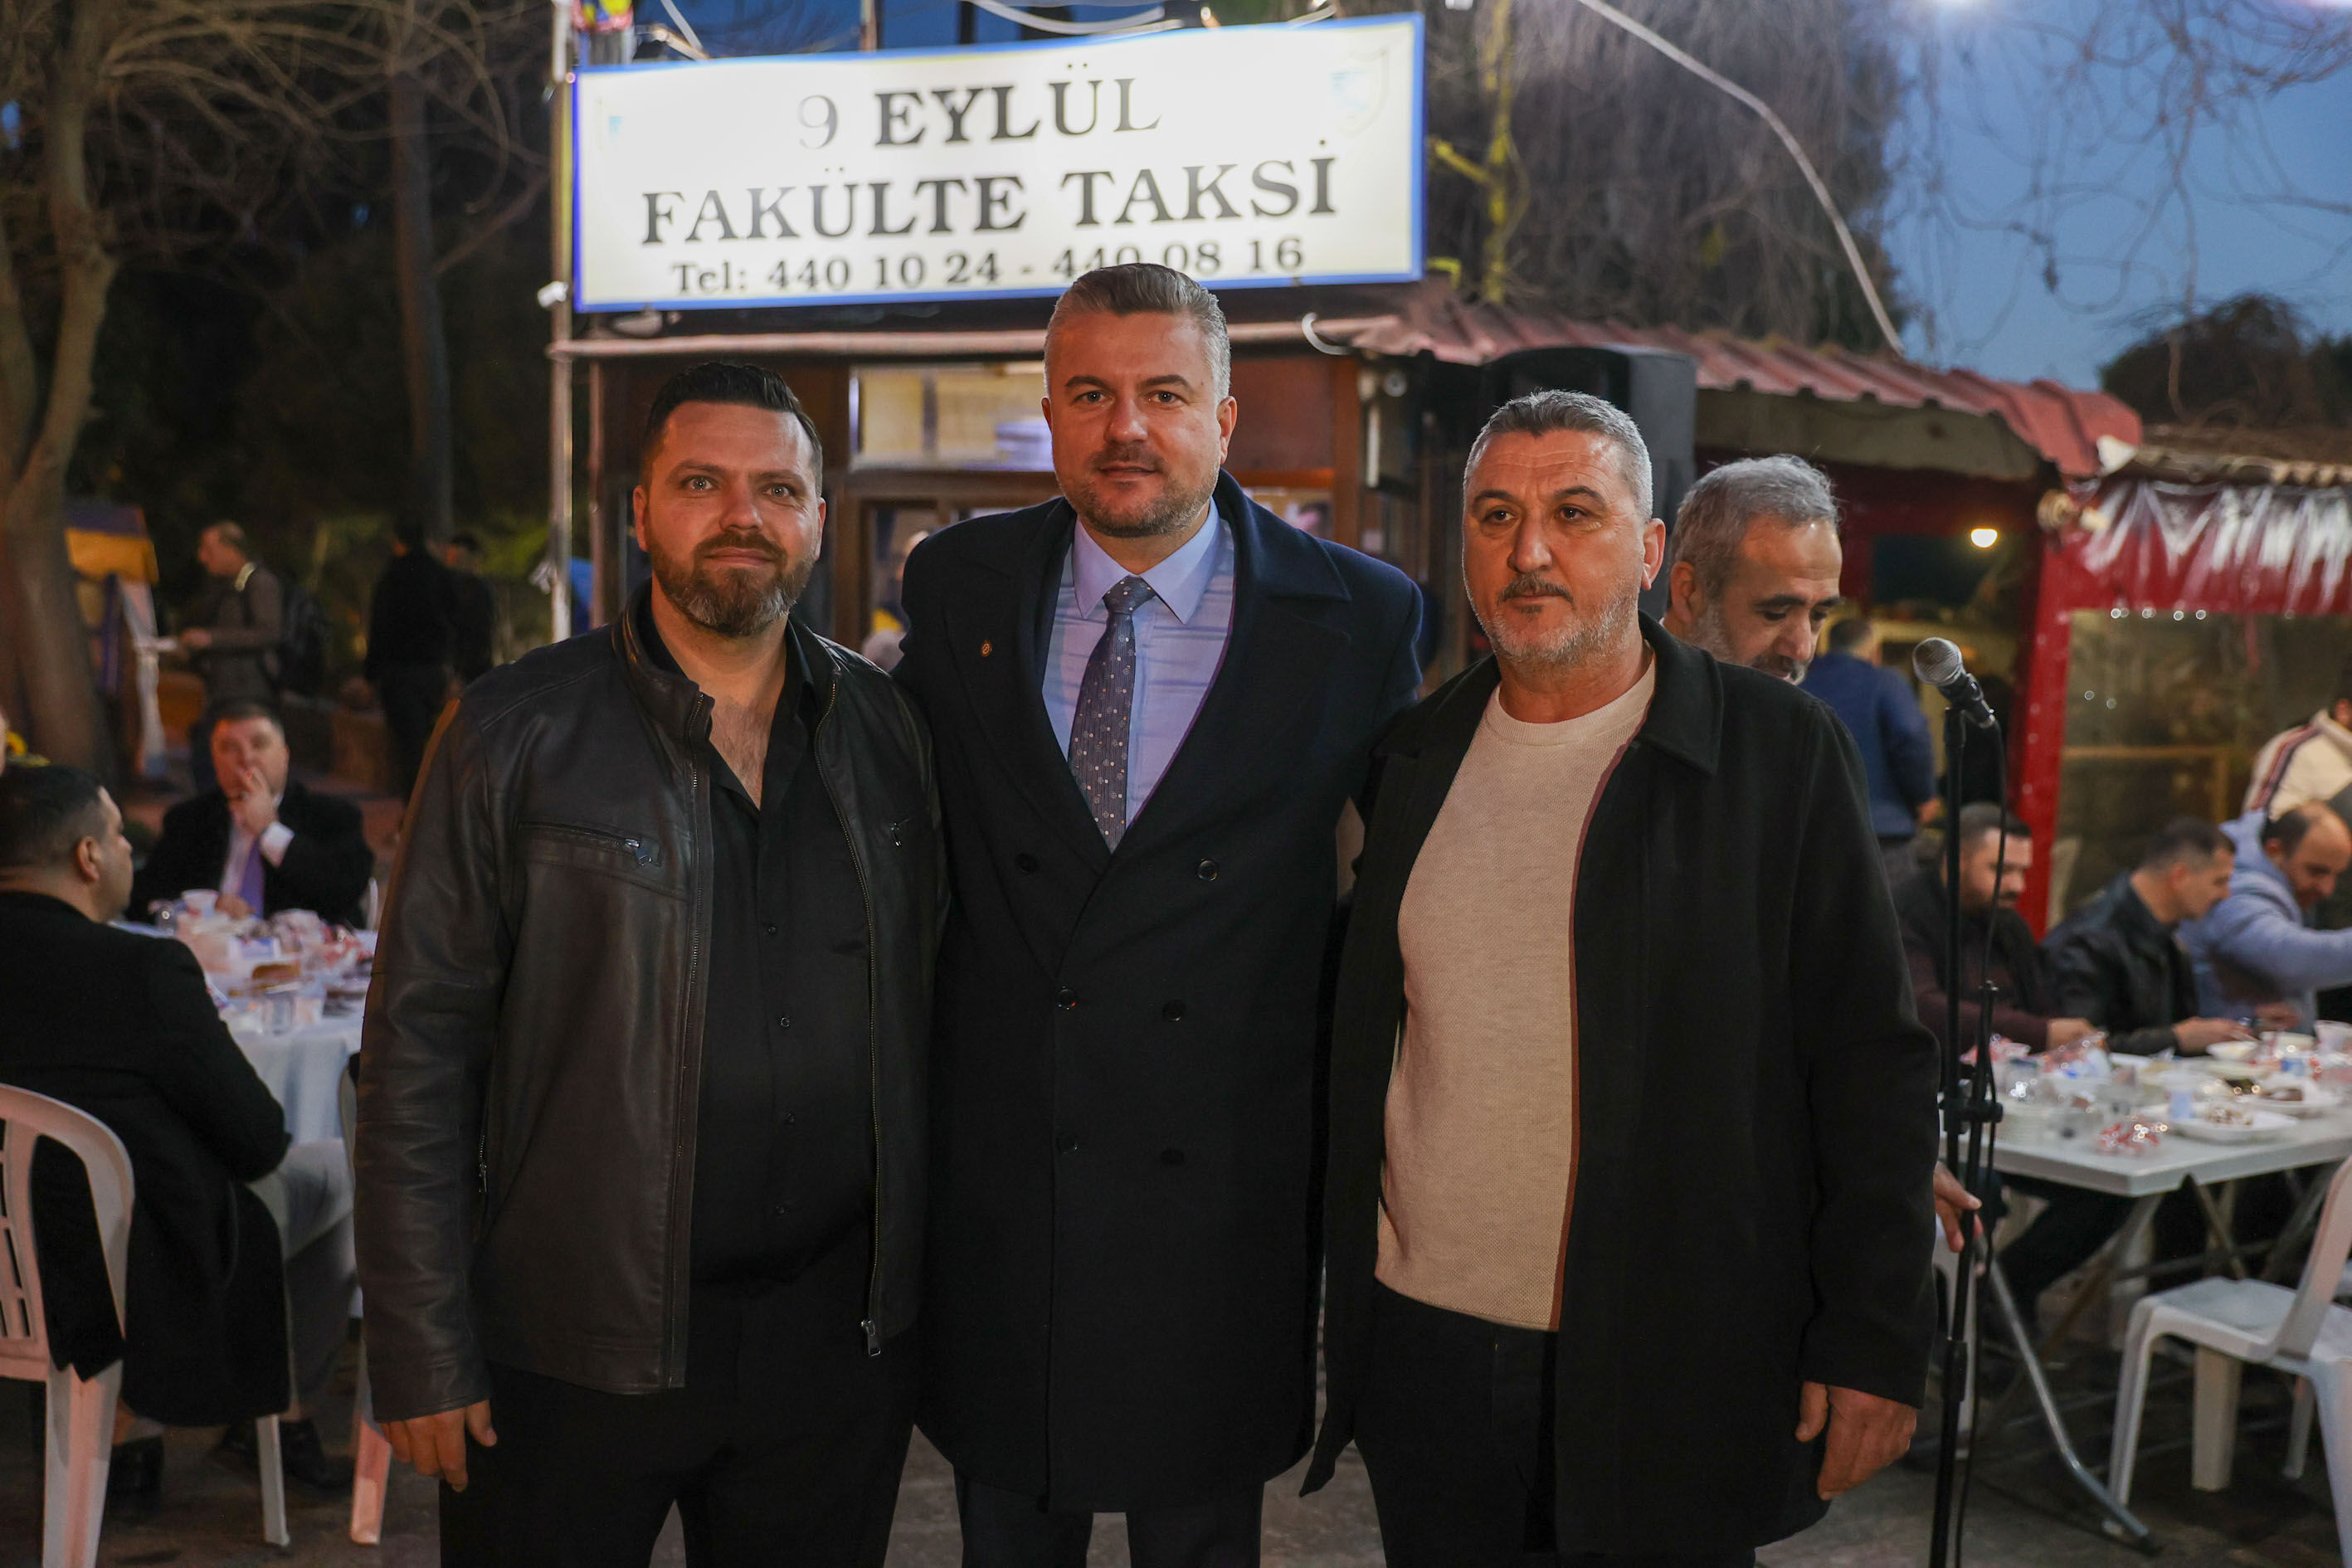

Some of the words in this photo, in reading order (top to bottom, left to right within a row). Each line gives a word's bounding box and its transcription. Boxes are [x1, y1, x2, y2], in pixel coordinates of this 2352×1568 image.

[797, 95, 839, 149] 9
[874, 62, 1162, 147] EYLÜL
[641, 168, 1027, 246] FAKÜLTE
[1060, 139, 1338, 226] TAKSİ
[672, 261, 747, 293] Tel:
[767, 258, 850, 290] 440
[874, 256, 927, 287] 10
[945, 252, 1001, 285] 24
[1163, 242, 1222, 275] 08
[1249, 238, 1303, 272] 16
